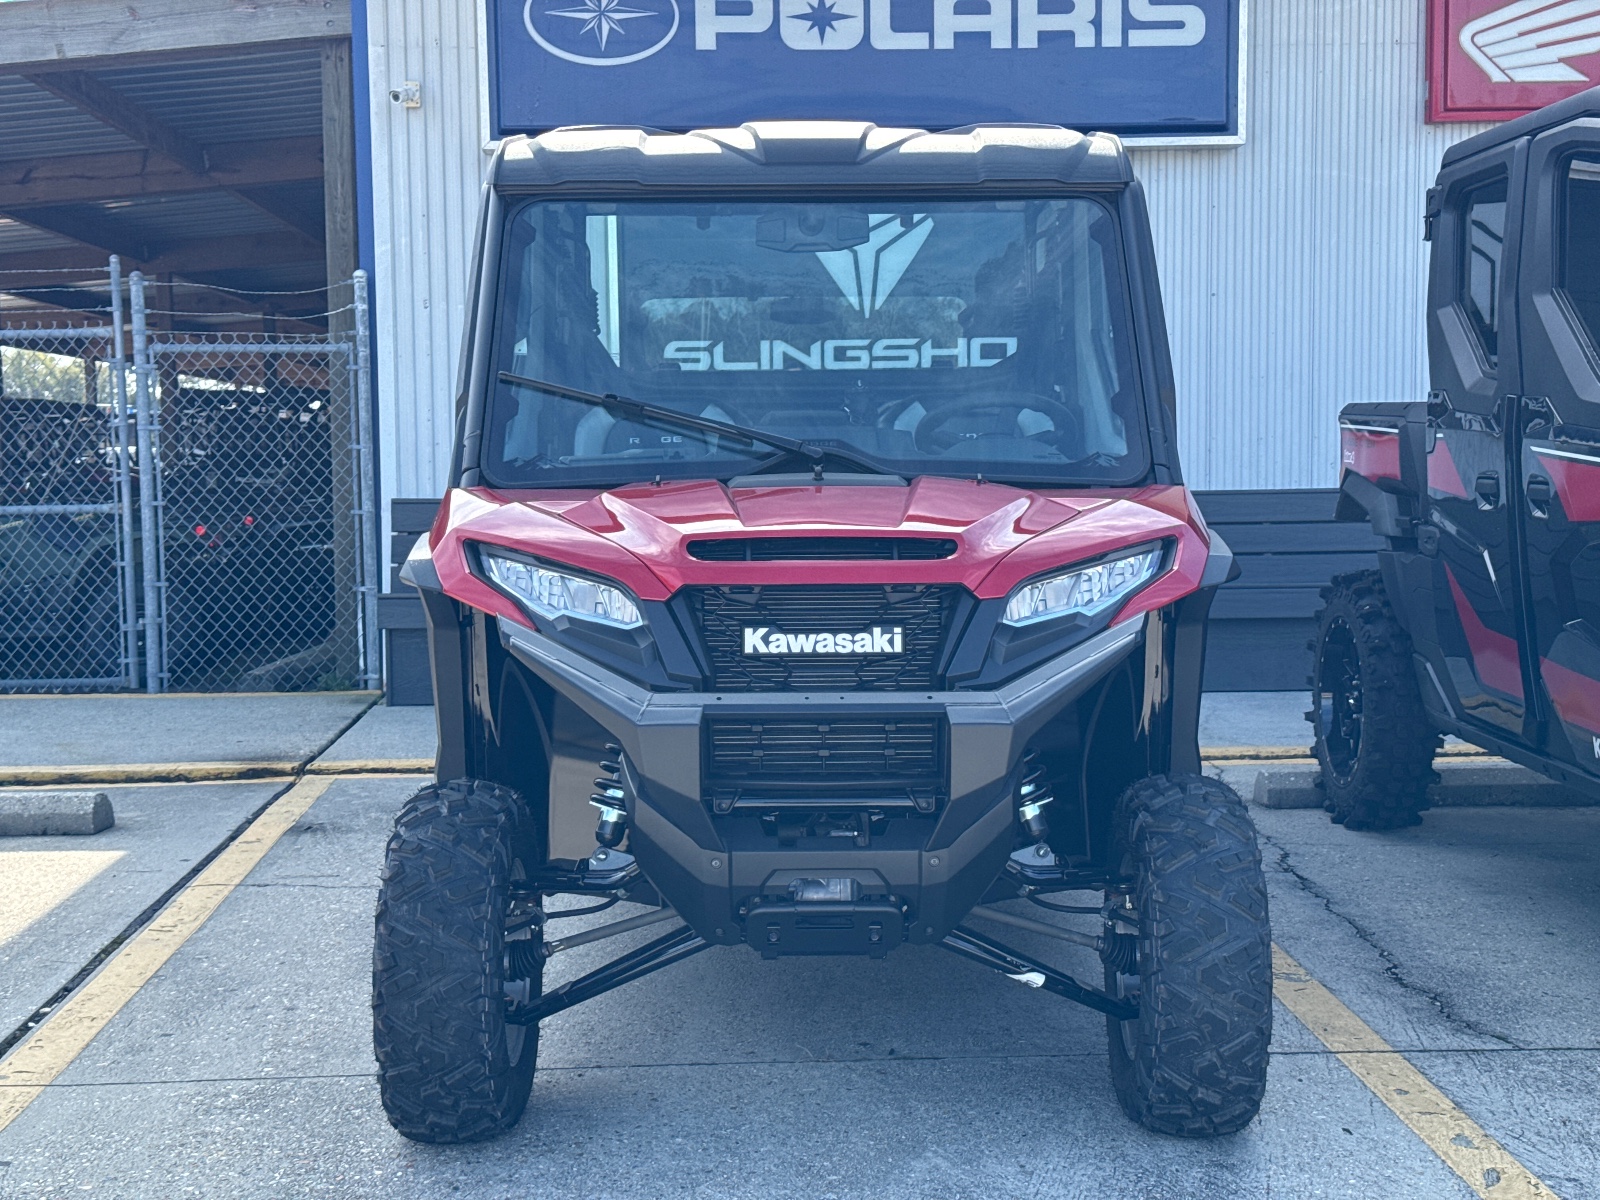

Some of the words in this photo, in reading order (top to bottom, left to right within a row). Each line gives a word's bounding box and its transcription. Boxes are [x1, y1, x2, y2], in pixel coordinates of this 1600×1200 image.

[695, 0, 1206, 50] POLARIS
[663, 337, 1018, 371] SLINGSHO
[744, 627, 902, 654] Kawasaki
